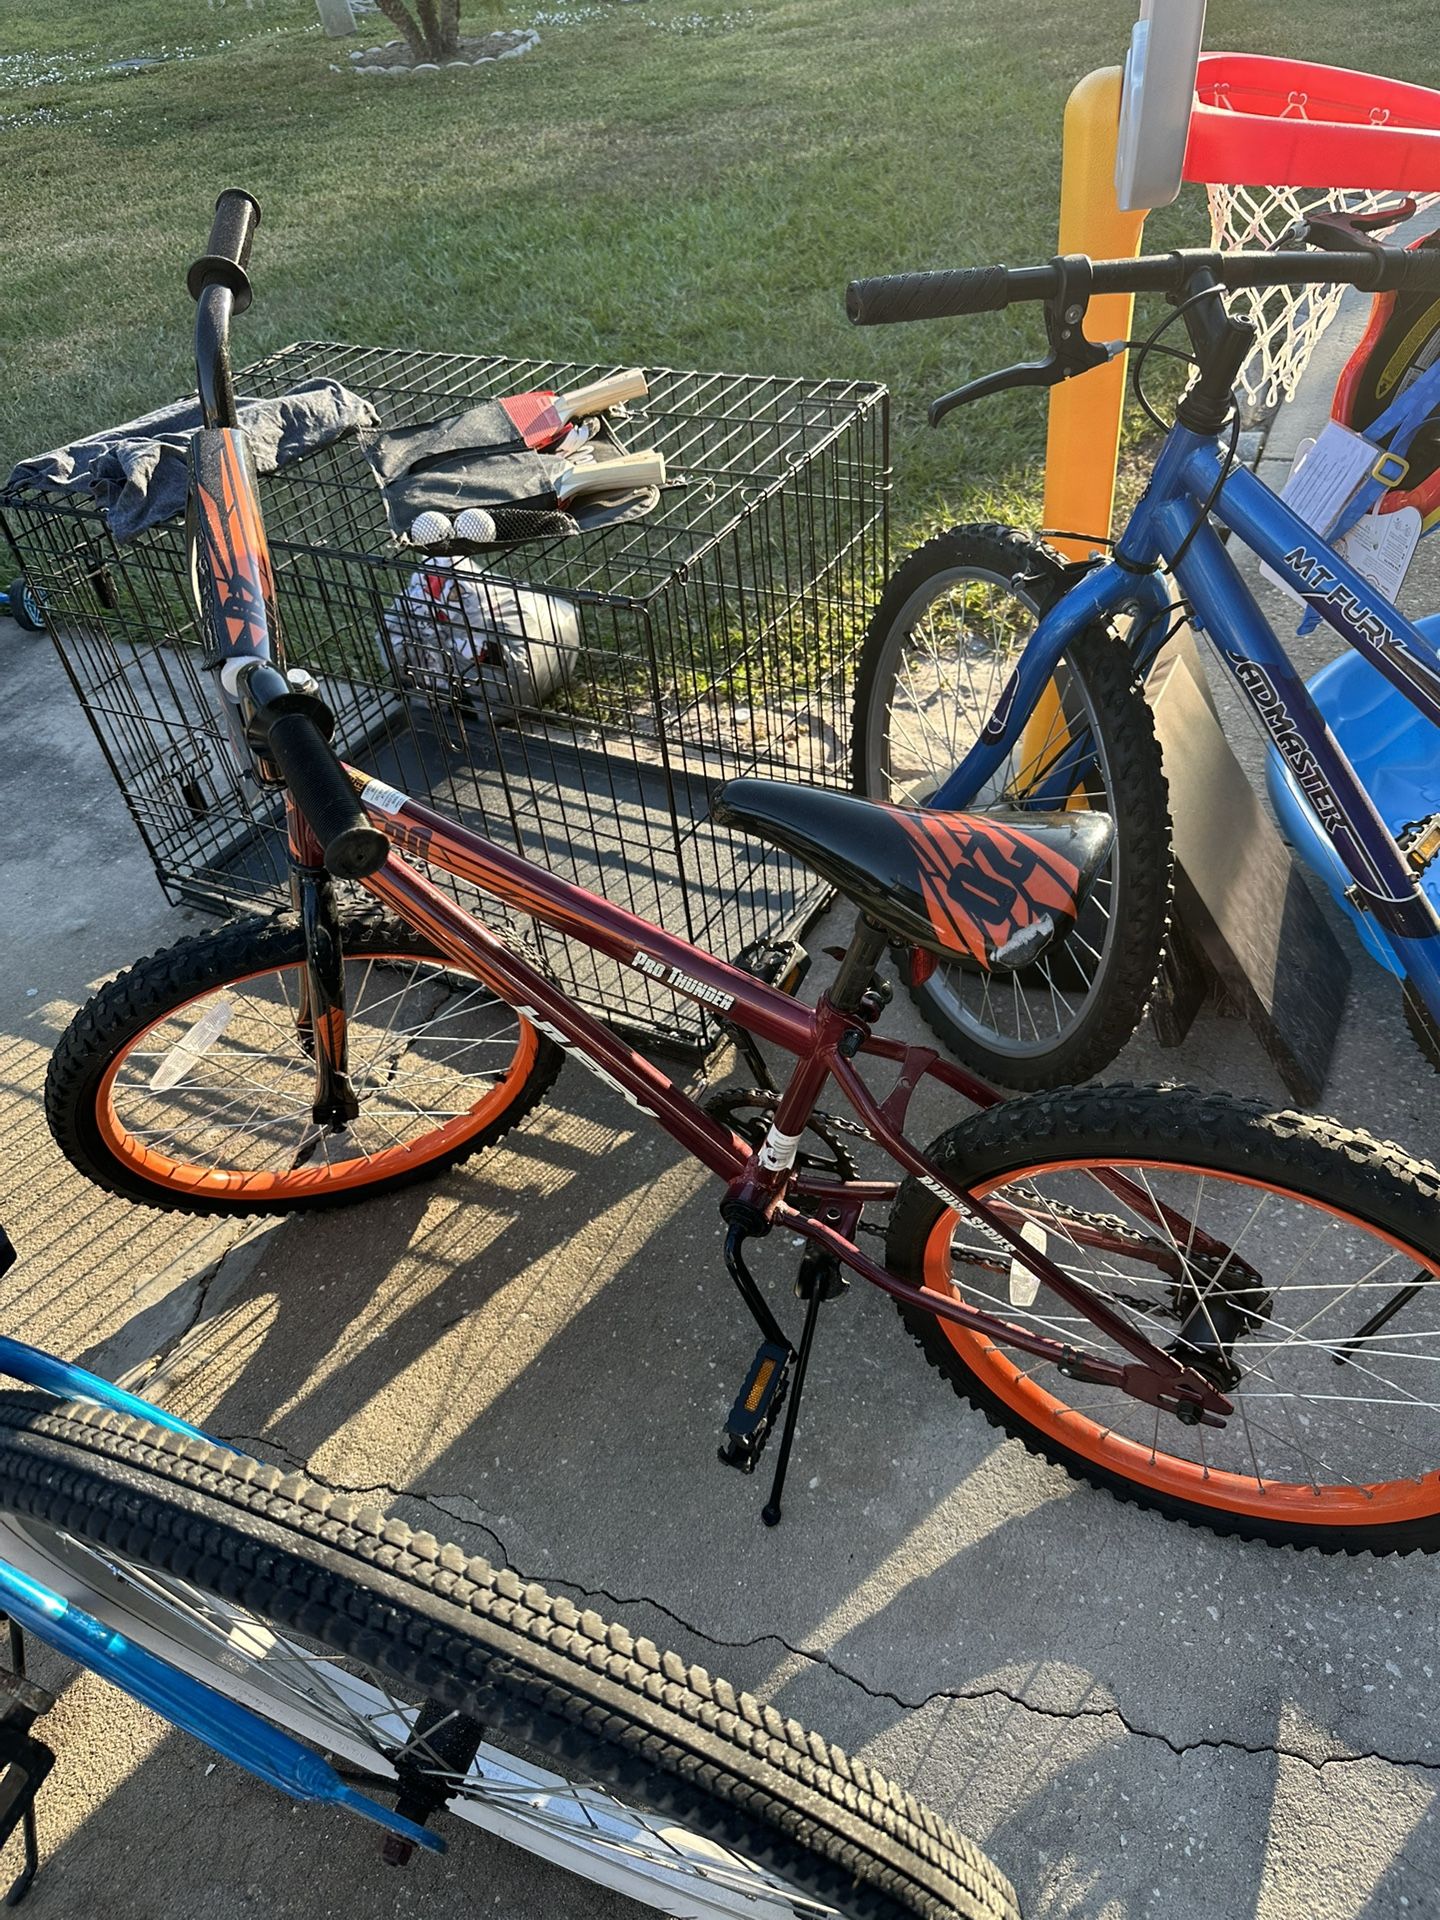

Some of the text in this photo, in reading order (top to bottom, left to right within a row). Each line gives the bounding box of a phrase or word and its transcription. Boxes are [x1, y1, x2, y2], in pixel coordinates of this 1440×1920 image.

[1284, 545, 1337, 589] MT
[1326, 582, 1409, 652] FURY
[1227, 650, 1348, 834] ADMASTER
[969, 1213, 1018, 1253] SERIES
